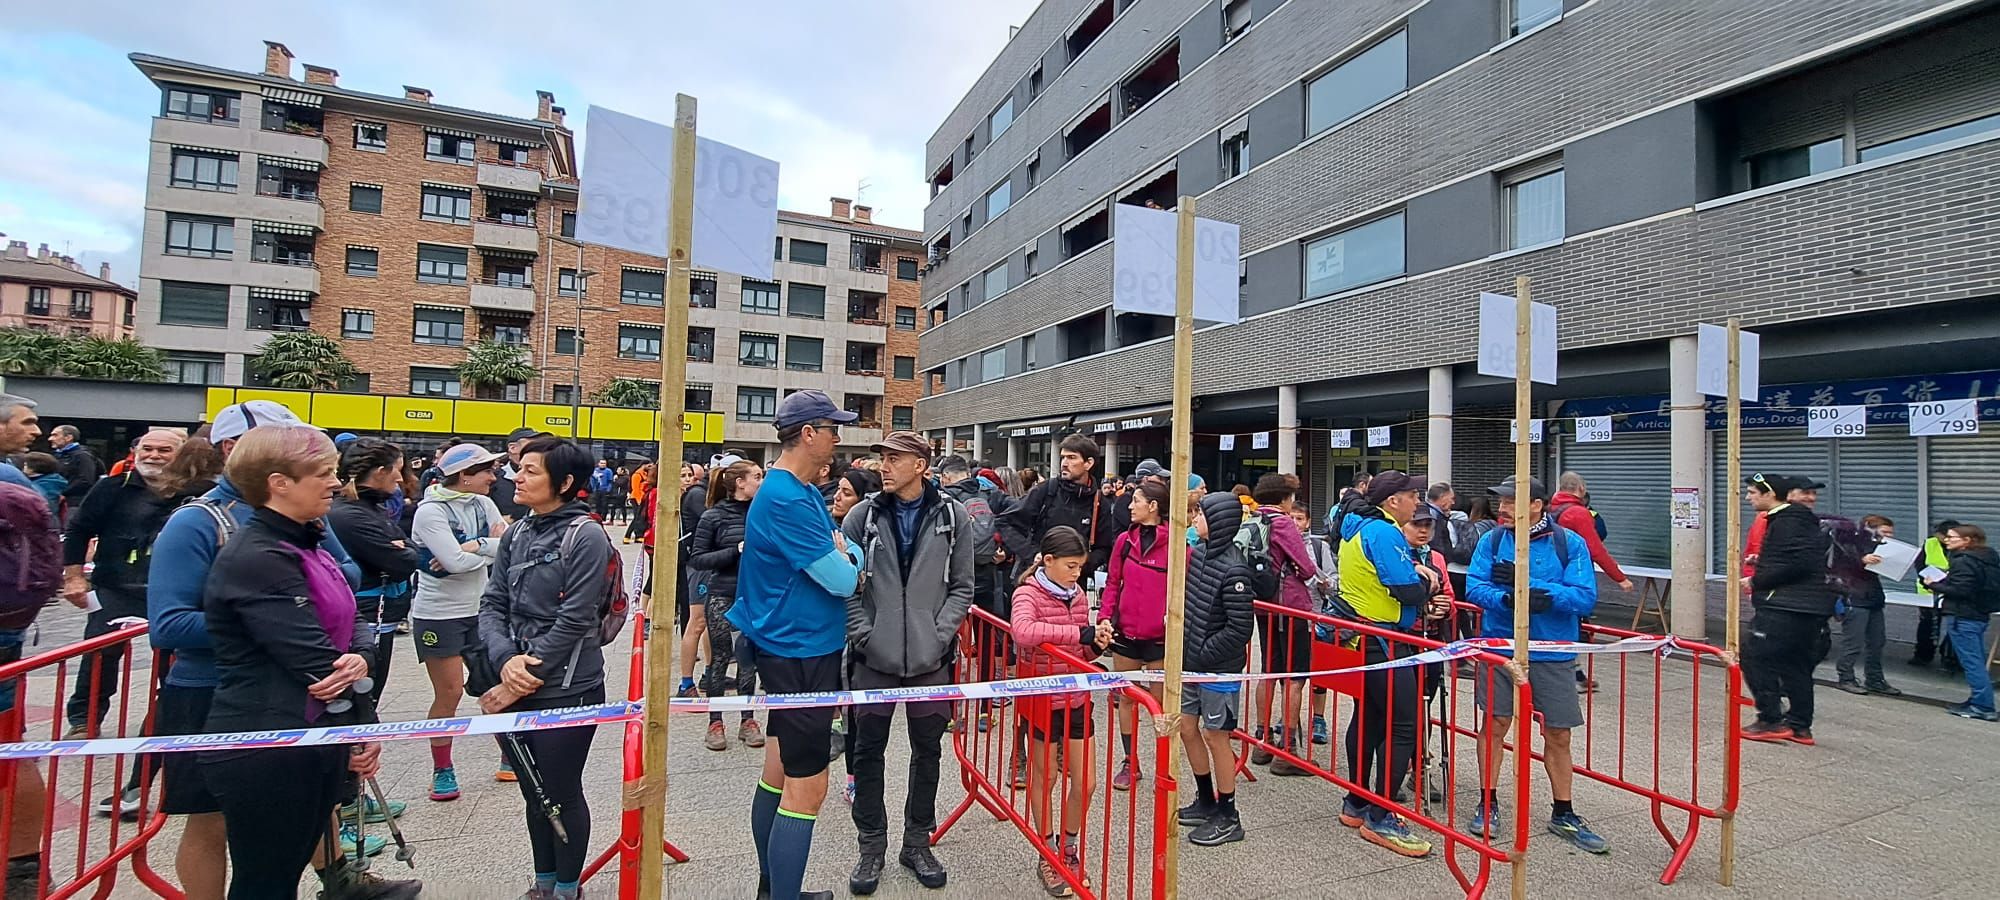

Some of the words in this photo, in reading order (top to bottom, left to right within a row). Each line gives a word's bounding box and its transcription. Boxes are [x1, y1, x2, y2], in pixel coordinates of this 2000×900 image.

[1809, 408, 1839, 420] 600
[1909, 404, 1945, 417] 700
[1577, 419, 1597, 428] 500
[1636, 420, 1671, 429] Articu
[1866, 410, 1908, 420] Ferre
[1833, 423, 1864, 435] 699
[1939, 419, 1977, 433] 799
[1368, 428, 1381, 436] 300
[1529, 432, 1540, 441] 99
[1590, 431, 1610, 440] 599
[1338, 439, 1350, 447] 299
[1376, 437, 1389, 445] 399
[1006, 678, 1063, 689] TODOTODO
[883, 688, 945, 696] TODOTODO
[352, 720, 447, 734] TODOTODO
[174, 732, 280, 744] TODOTODO
[0, 742, 56, 752] TODO
